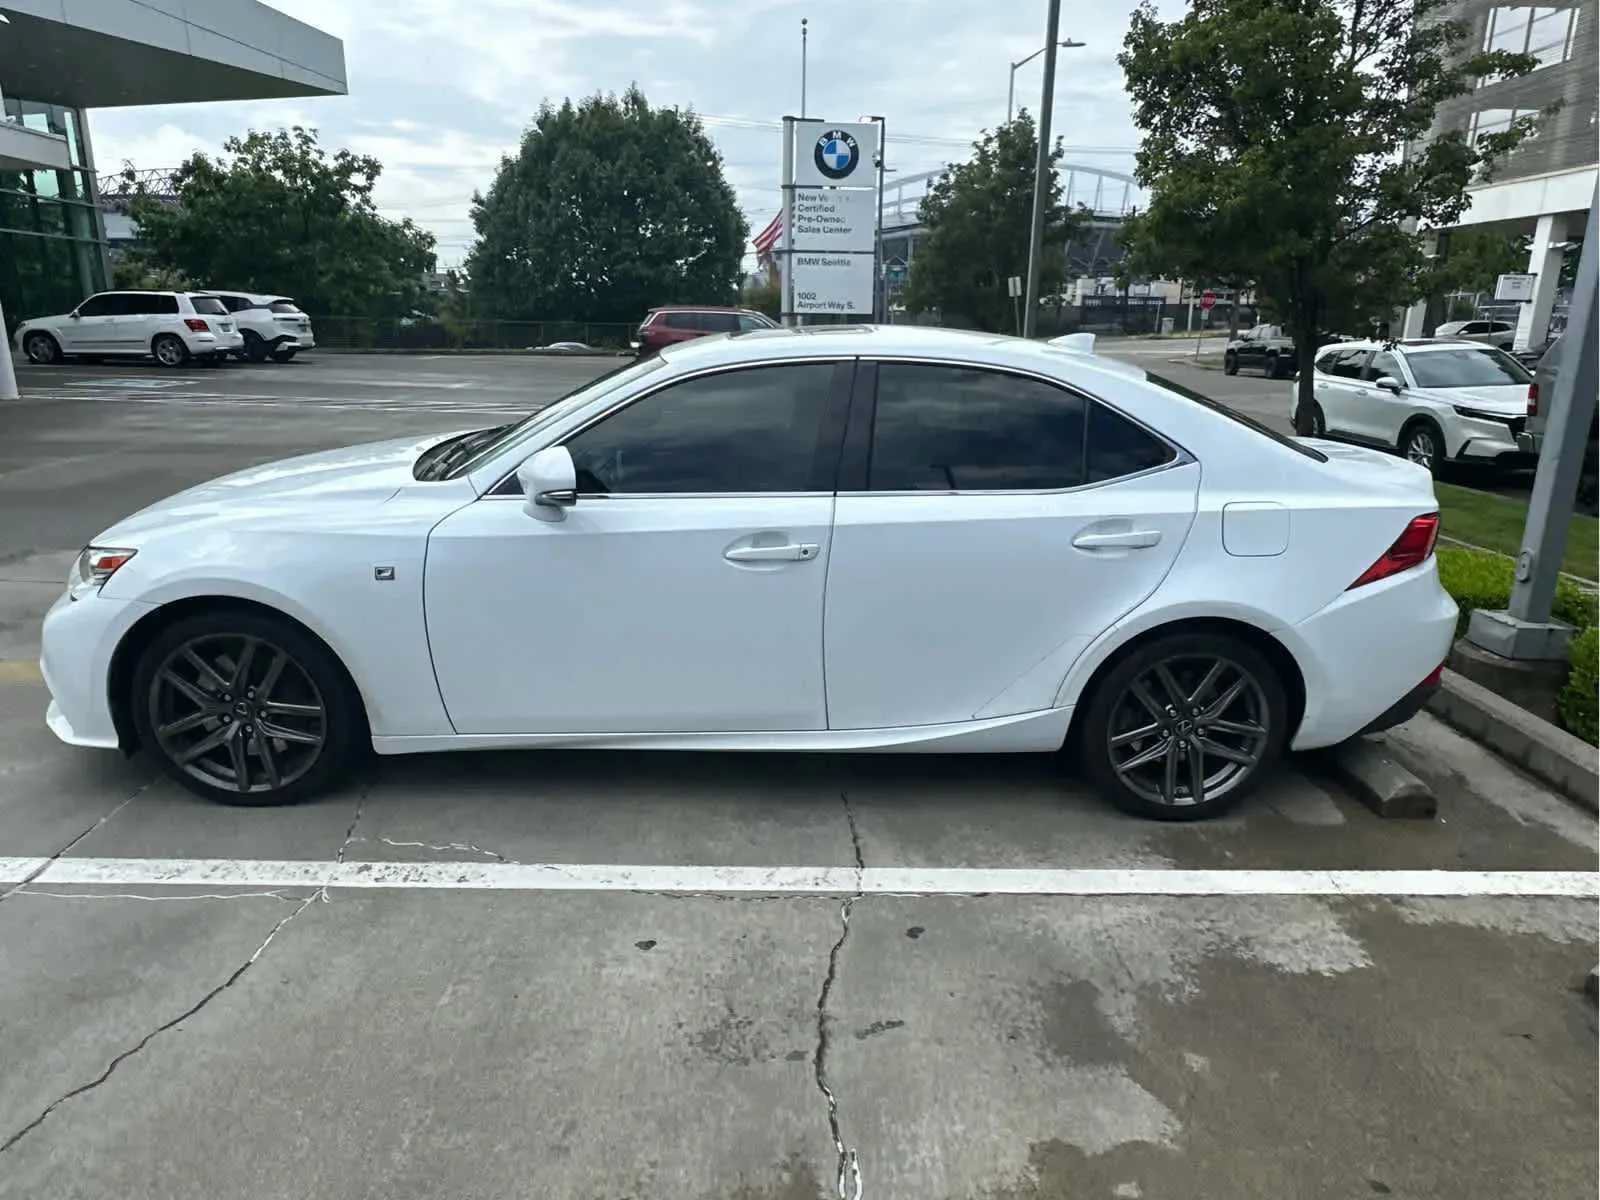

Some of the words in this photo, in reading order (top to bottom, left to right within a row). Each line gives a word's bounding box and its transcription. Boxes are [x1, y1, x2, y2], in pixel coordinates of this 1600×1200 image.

[819, 131, 856, 147] BMW
[798, 193, 817, 201] New
[798, 204, 835, 212] Certified
[797, 225, 821, 233] Sales
[798, 292, 816, 300] 1002
[797, 301, 826, 310] Airport
[828, 301, 845, 311] Way
[847, 301, 856, 309] S.
